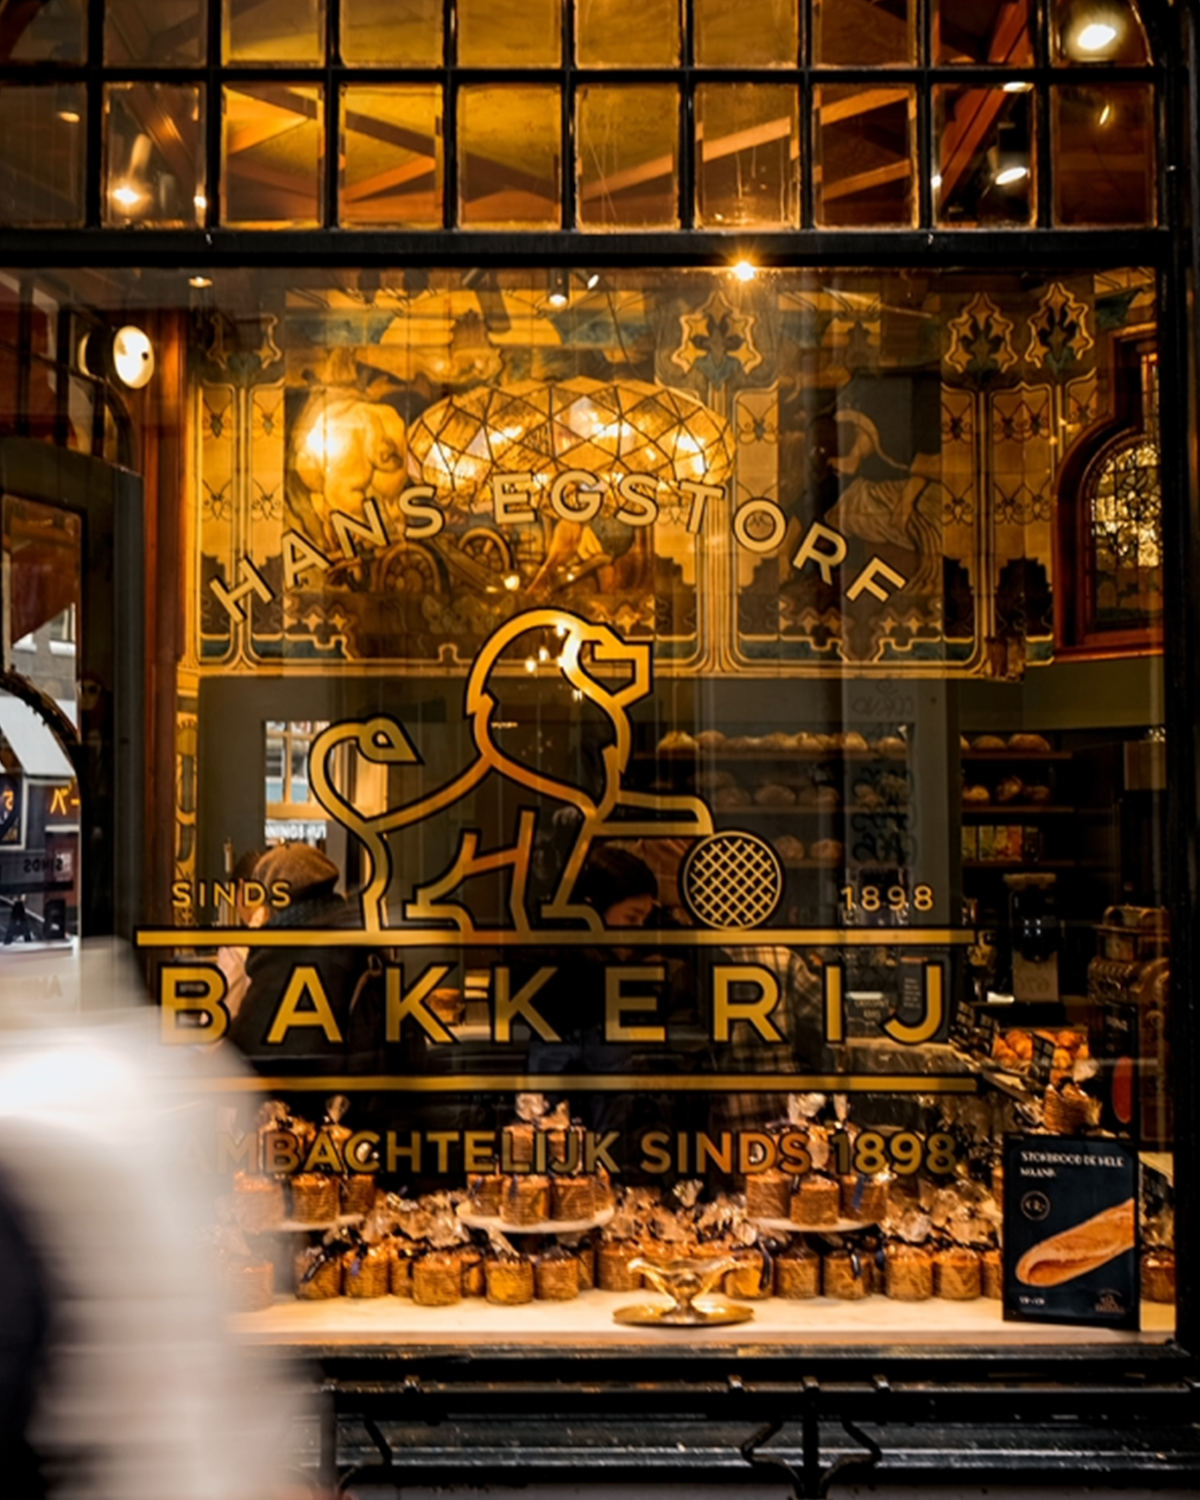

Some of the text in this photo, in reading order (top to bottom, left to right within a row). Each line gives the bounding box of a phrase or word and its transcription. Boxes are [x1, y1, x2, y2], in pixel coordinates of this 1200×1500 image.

[209, 470, 907, 625] HANS EGSTORF
[171, 881, 292, 909] SINDS
[840, 885, 934, 912] 1898
[159, 963, 942, 1045] BAKKERIJ
[215, 1130, 958, 1176] MBACHTELIJK SINDS 1898
